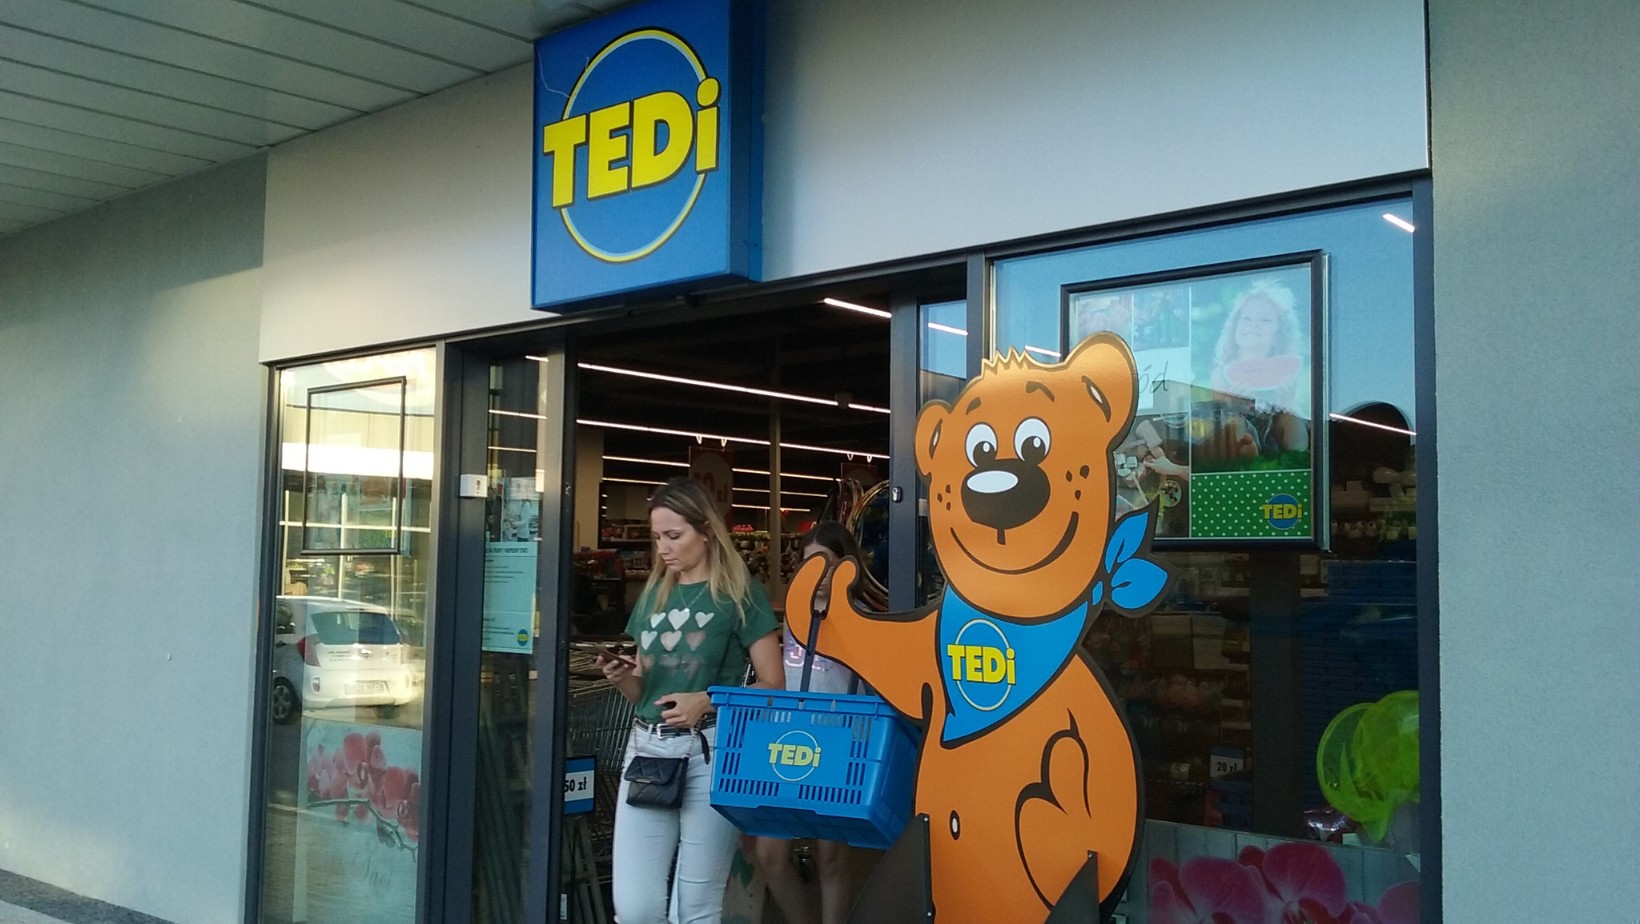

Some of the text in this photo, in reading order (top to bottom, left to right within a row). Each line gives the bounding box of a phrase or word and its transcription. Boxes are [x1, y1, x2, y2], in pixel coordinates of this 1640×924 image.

[543, 77, 720, 208] TEDi
[1139, 361, 1168, 393] ód
[1262, 503, 1303, 519] TEDi
[947, 644, 1016, 685] TEDi
[768, 743, 821, 767] TEDi
[1216, 761, 1227, 772] 20
[577, 776, 587, 791] zł
